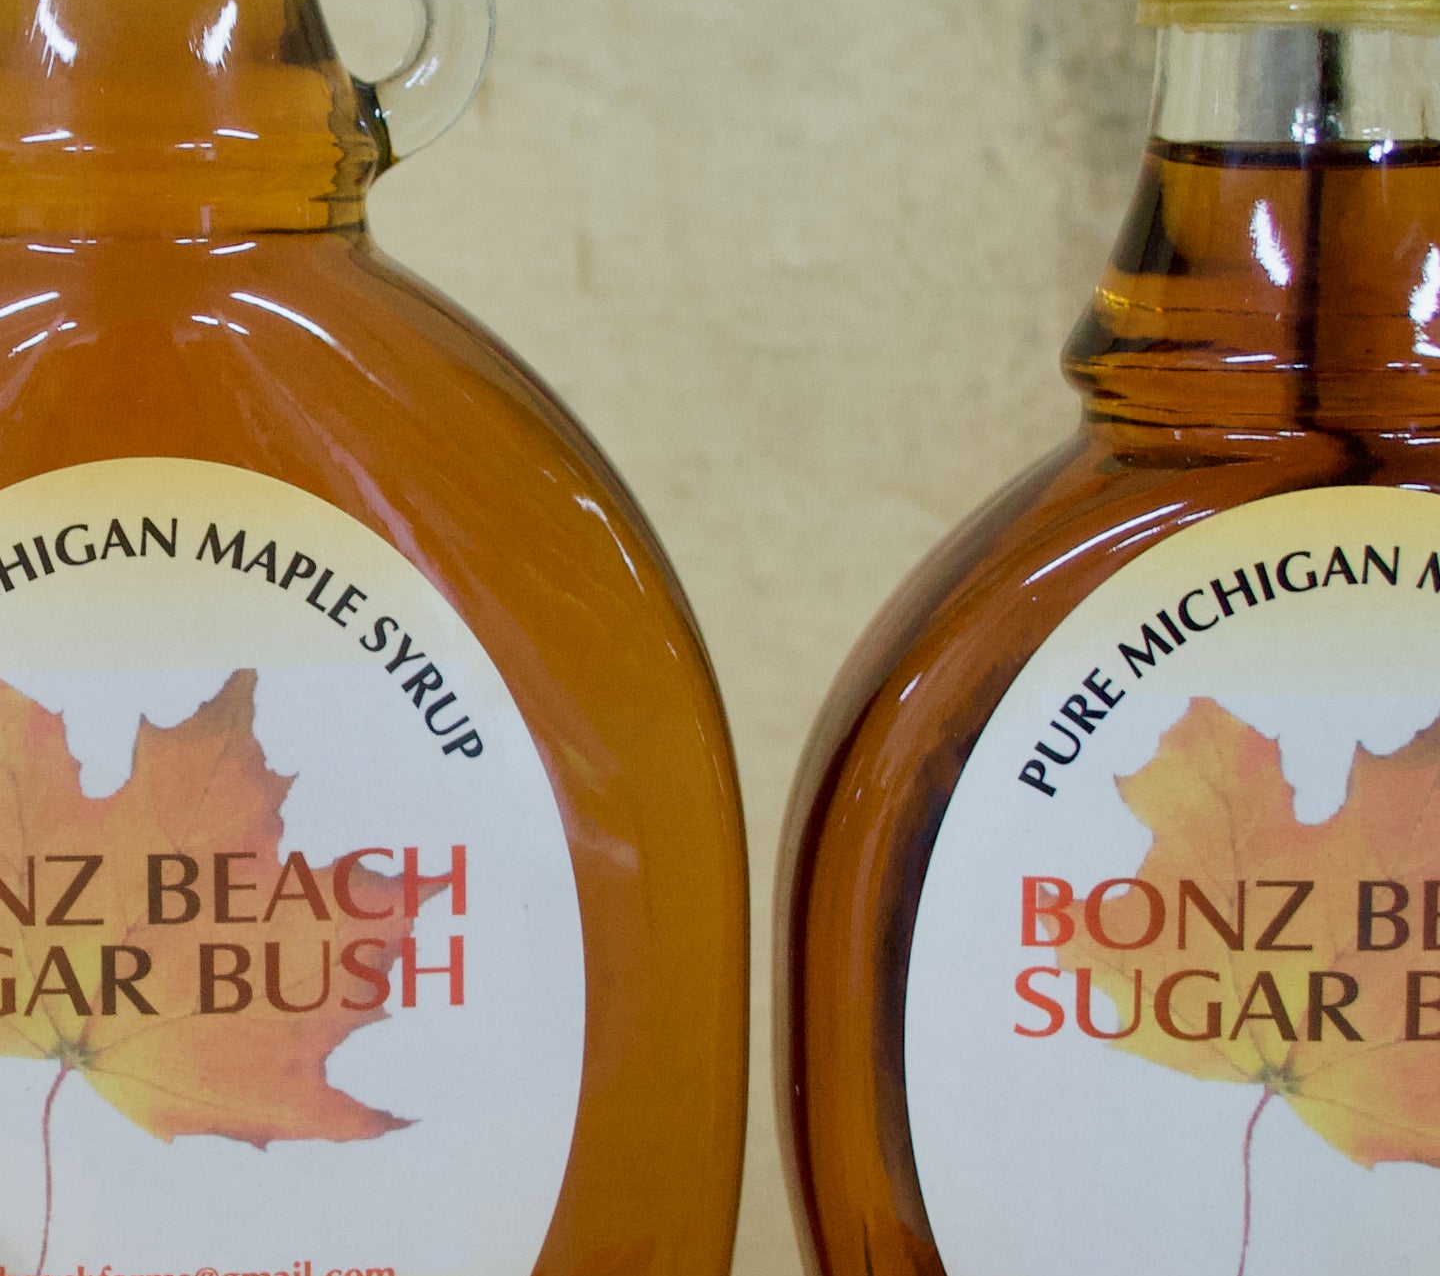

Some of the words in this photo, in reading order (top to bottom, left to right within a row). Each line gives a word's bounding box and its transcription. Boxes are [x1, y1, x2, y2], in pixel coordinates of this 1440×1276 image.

[195, 521, 368, 631] MAPLE
[359, 615, 486, 764] SYRUP
[1017, 666, 1126, 799] PURE
[1116, 543, 1403, 680] MICHIGAN
[147, 843, 468, 926] BEACH
[1020, 875, 1317, 952] BONZ
[198, 935, 466, 1014] BUSH
[1012, 965, 1362, 1043] SUGAR
